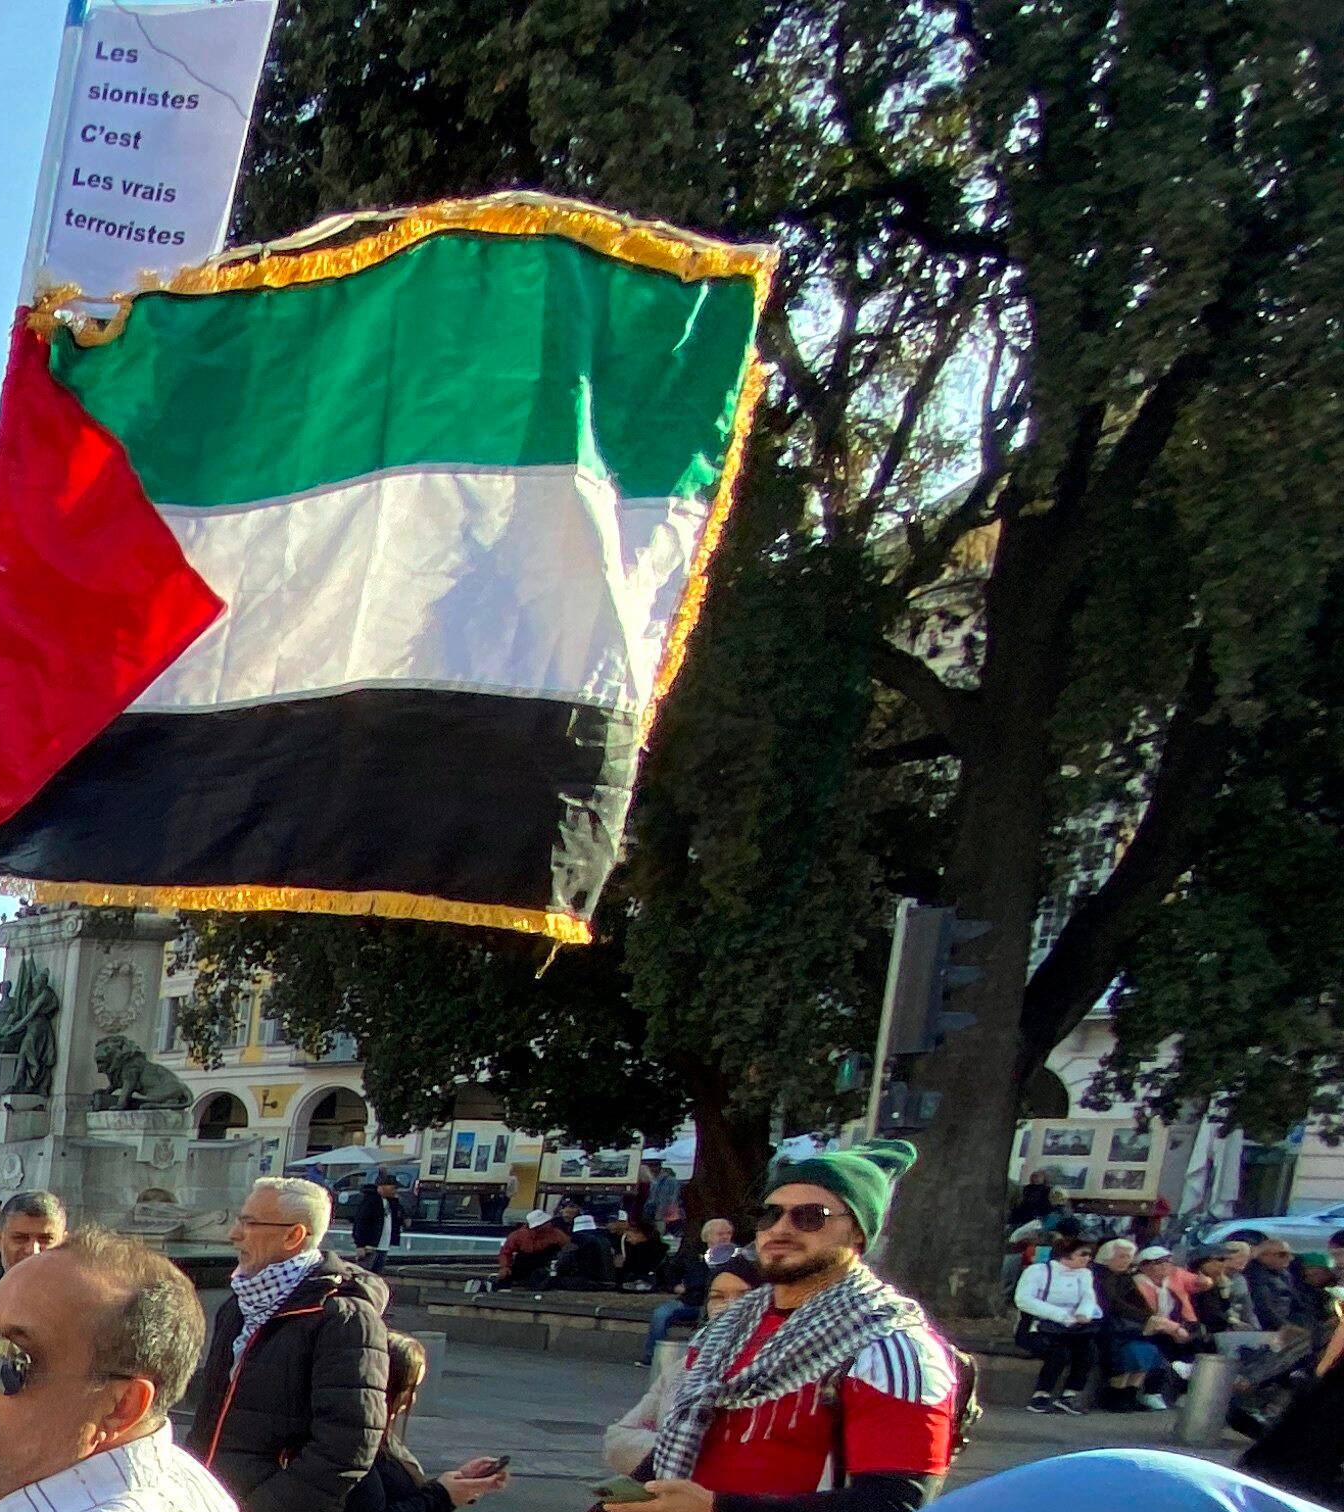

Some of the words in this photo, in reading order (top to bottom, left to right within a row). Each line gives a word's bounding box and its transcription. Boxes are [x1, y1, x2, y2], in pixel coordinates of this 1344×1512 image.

[95, 40, 139, 64] Les
[88, 82, 200, 110] sionistes
[80, 124, 142, 150] C'est
[71, 167, 114, 191] Les
[122, 178, 177, 203] vrais
[65, 208, 186, 246] terroristes
